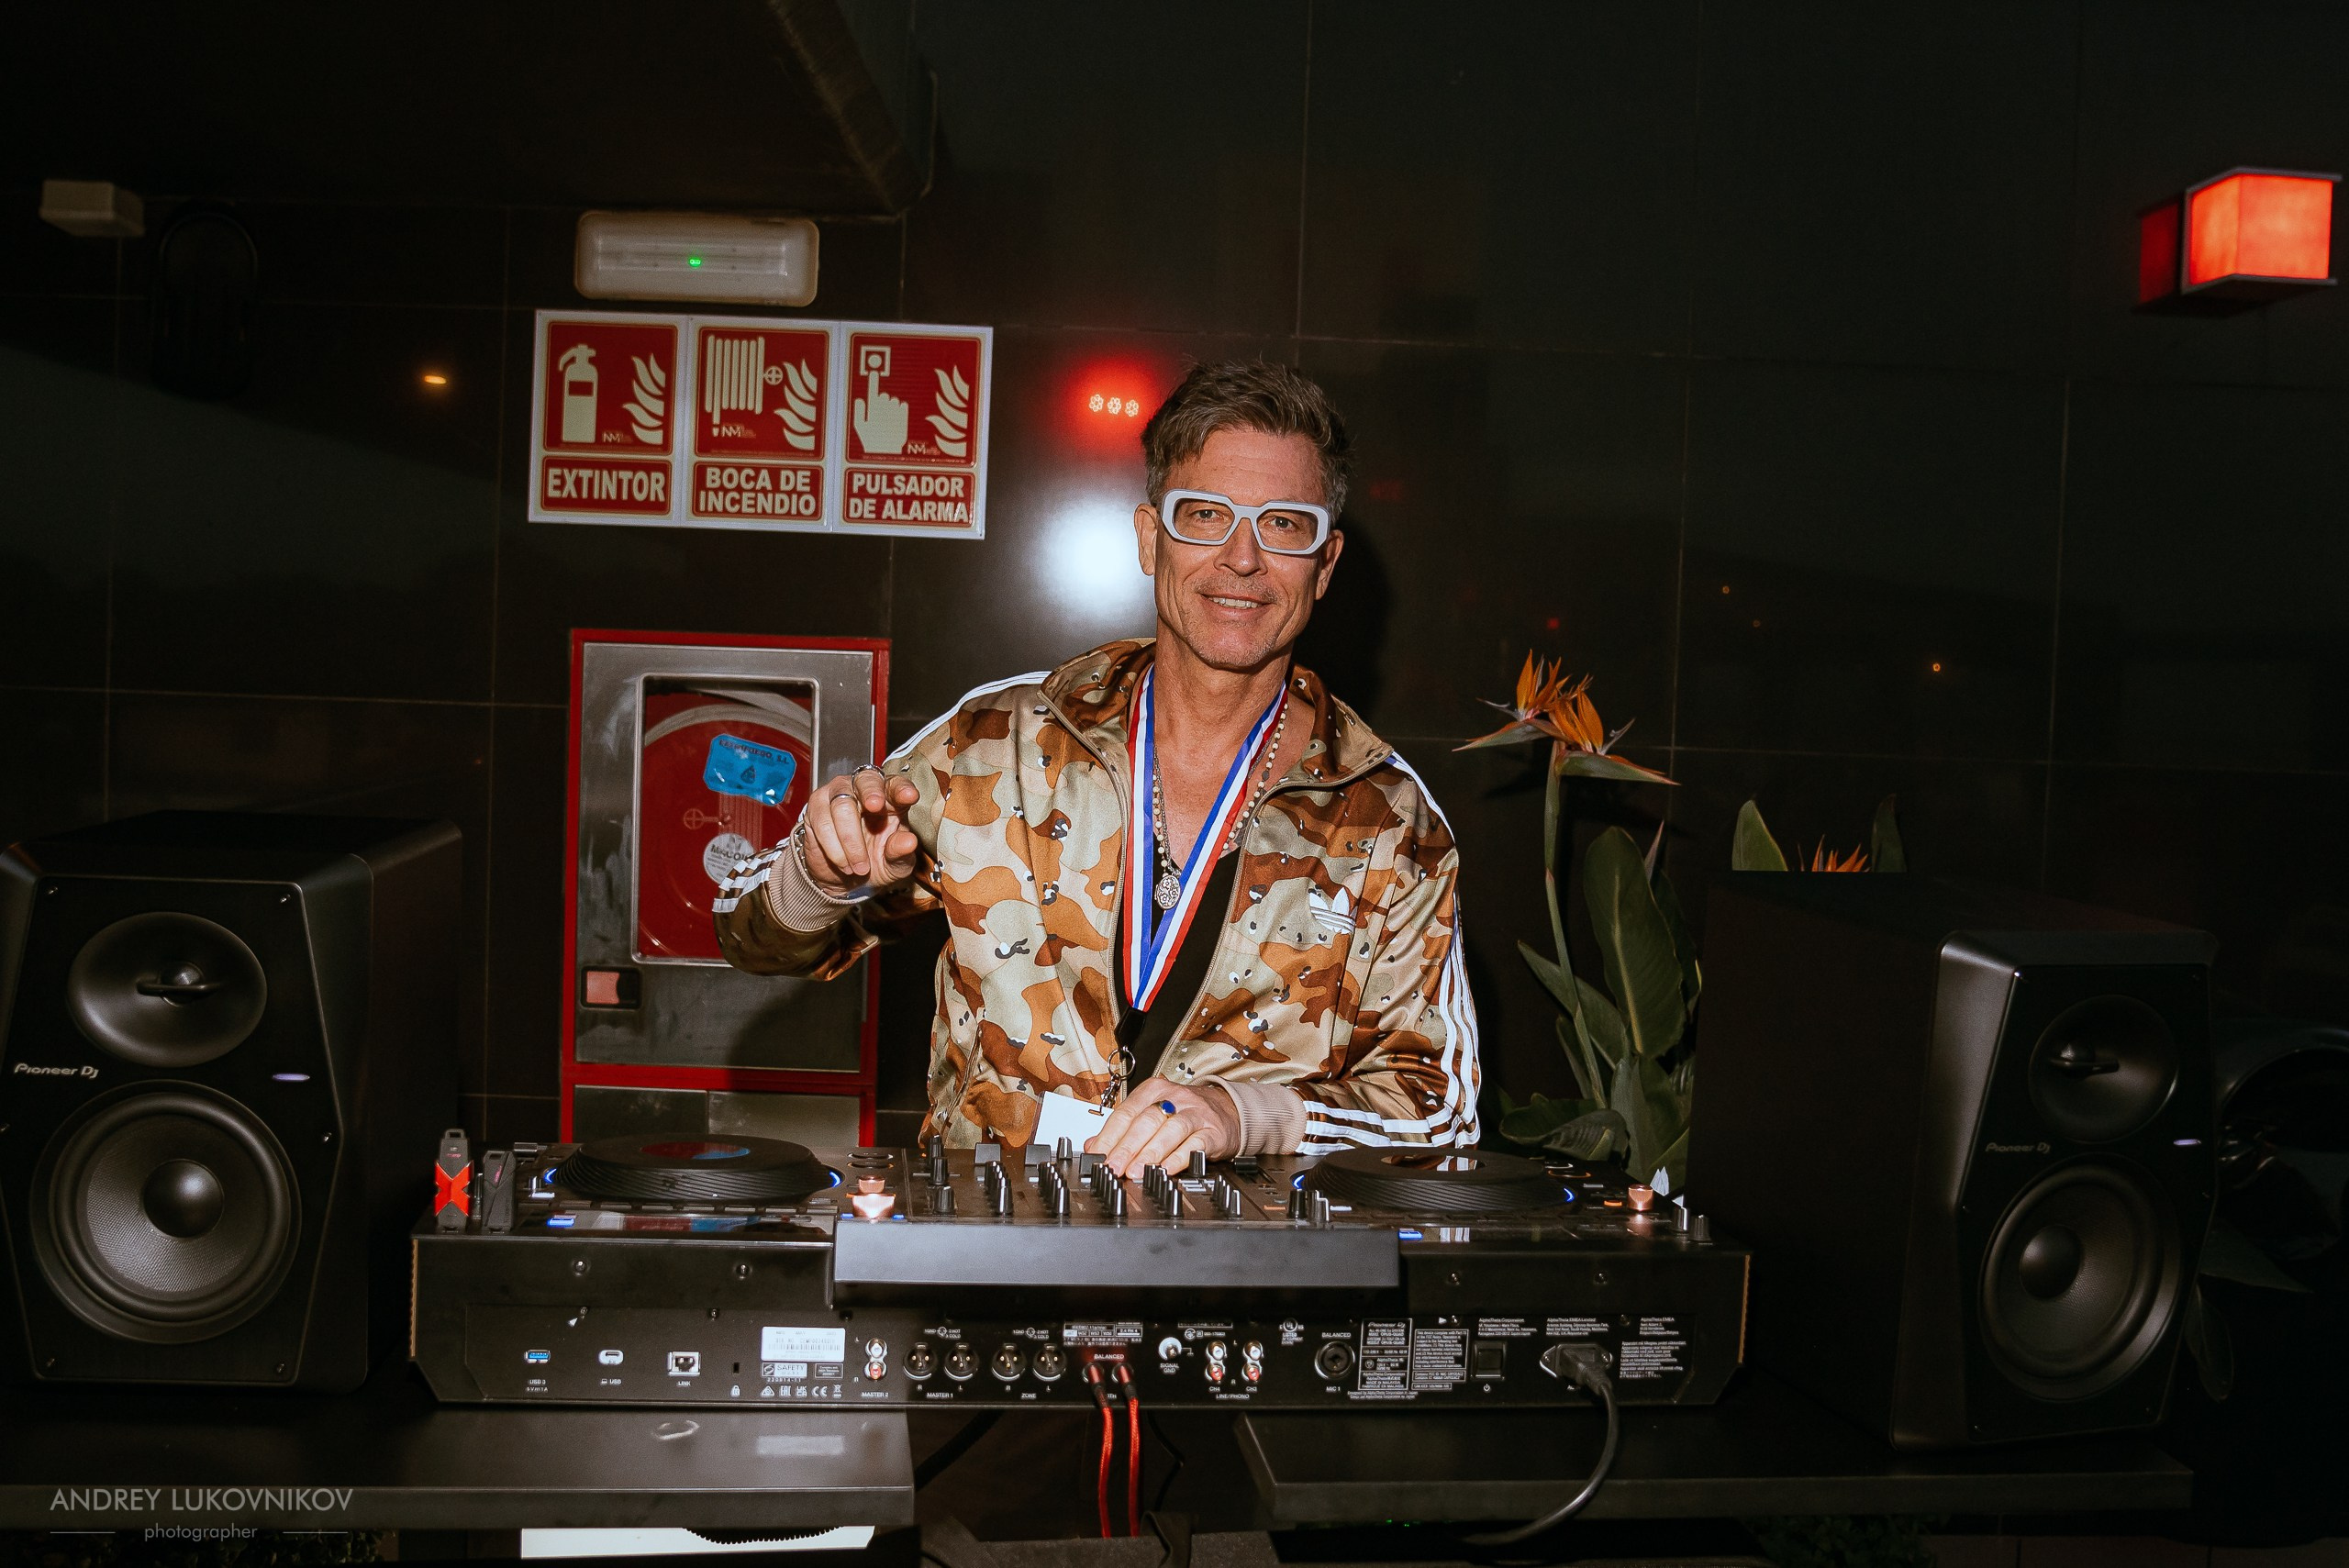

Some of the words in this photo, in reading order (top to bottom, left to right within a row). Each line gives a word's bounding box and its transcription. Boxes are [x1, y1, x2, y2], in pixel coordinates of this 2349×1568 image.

[548, 468, 665, 503] EXTINTOR
[707, 466, 773, 491] BOCA
[780, 469, 811, 493] DE
[852, 473, 964, 497] PULSADOR
[699, 490, 816, 516] INCENDIO
[849, 497, 876, 518] DE
[882, 499, 969, 523] ALARMA
[14, 1062, 78, 1075] Pioneer
[1985, 1141, 2034, 1152] Pioneer
